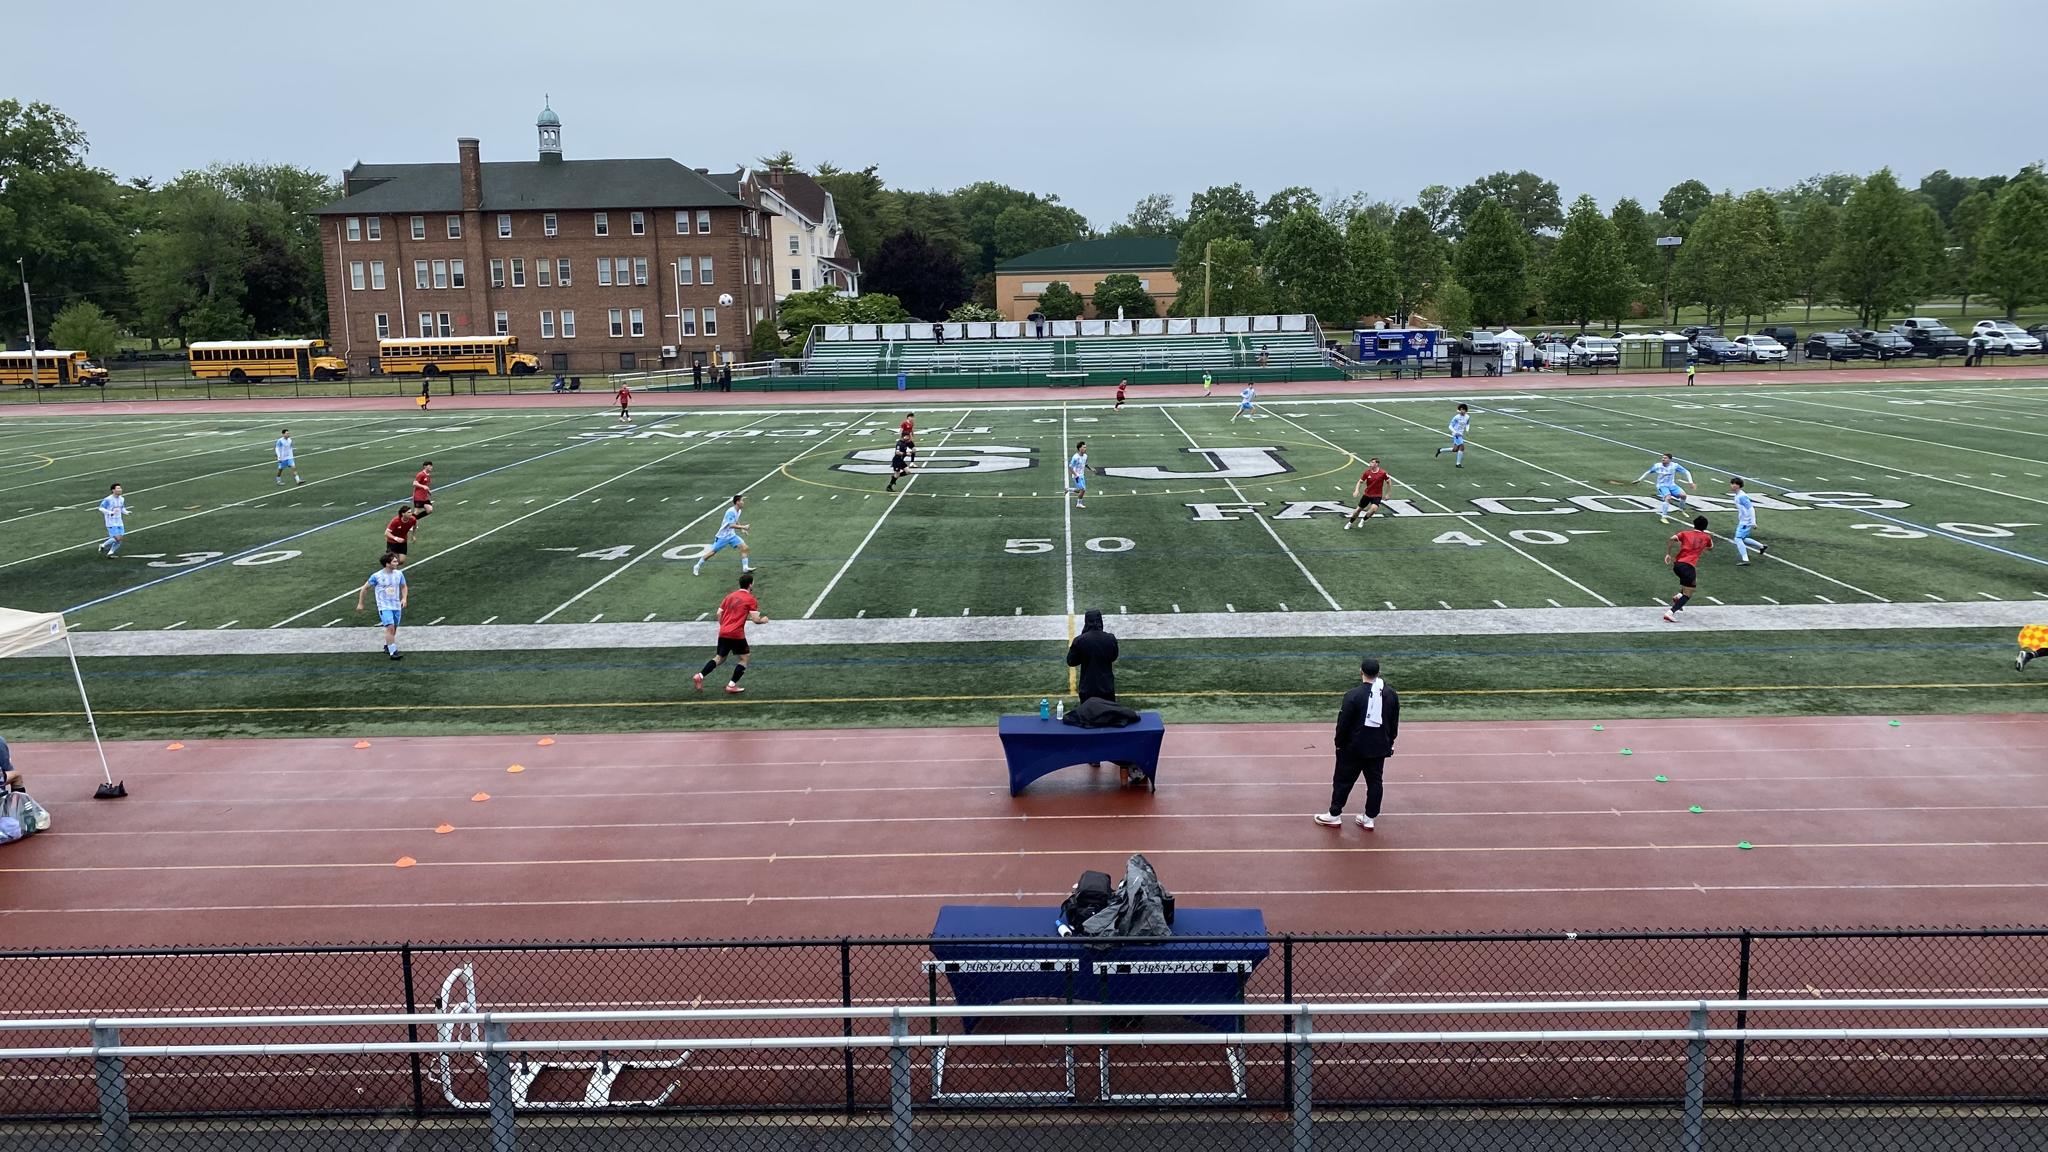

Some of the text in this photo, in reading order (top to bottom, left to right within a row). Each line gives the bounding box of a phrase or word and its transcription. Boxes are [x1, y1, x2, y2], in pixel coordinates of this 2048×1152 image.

[1184, 491, 1912, 521] FALCONS
[1002, 961, 1036, 971] PLACE
[1174, 962, 1209, 973] PLACE
